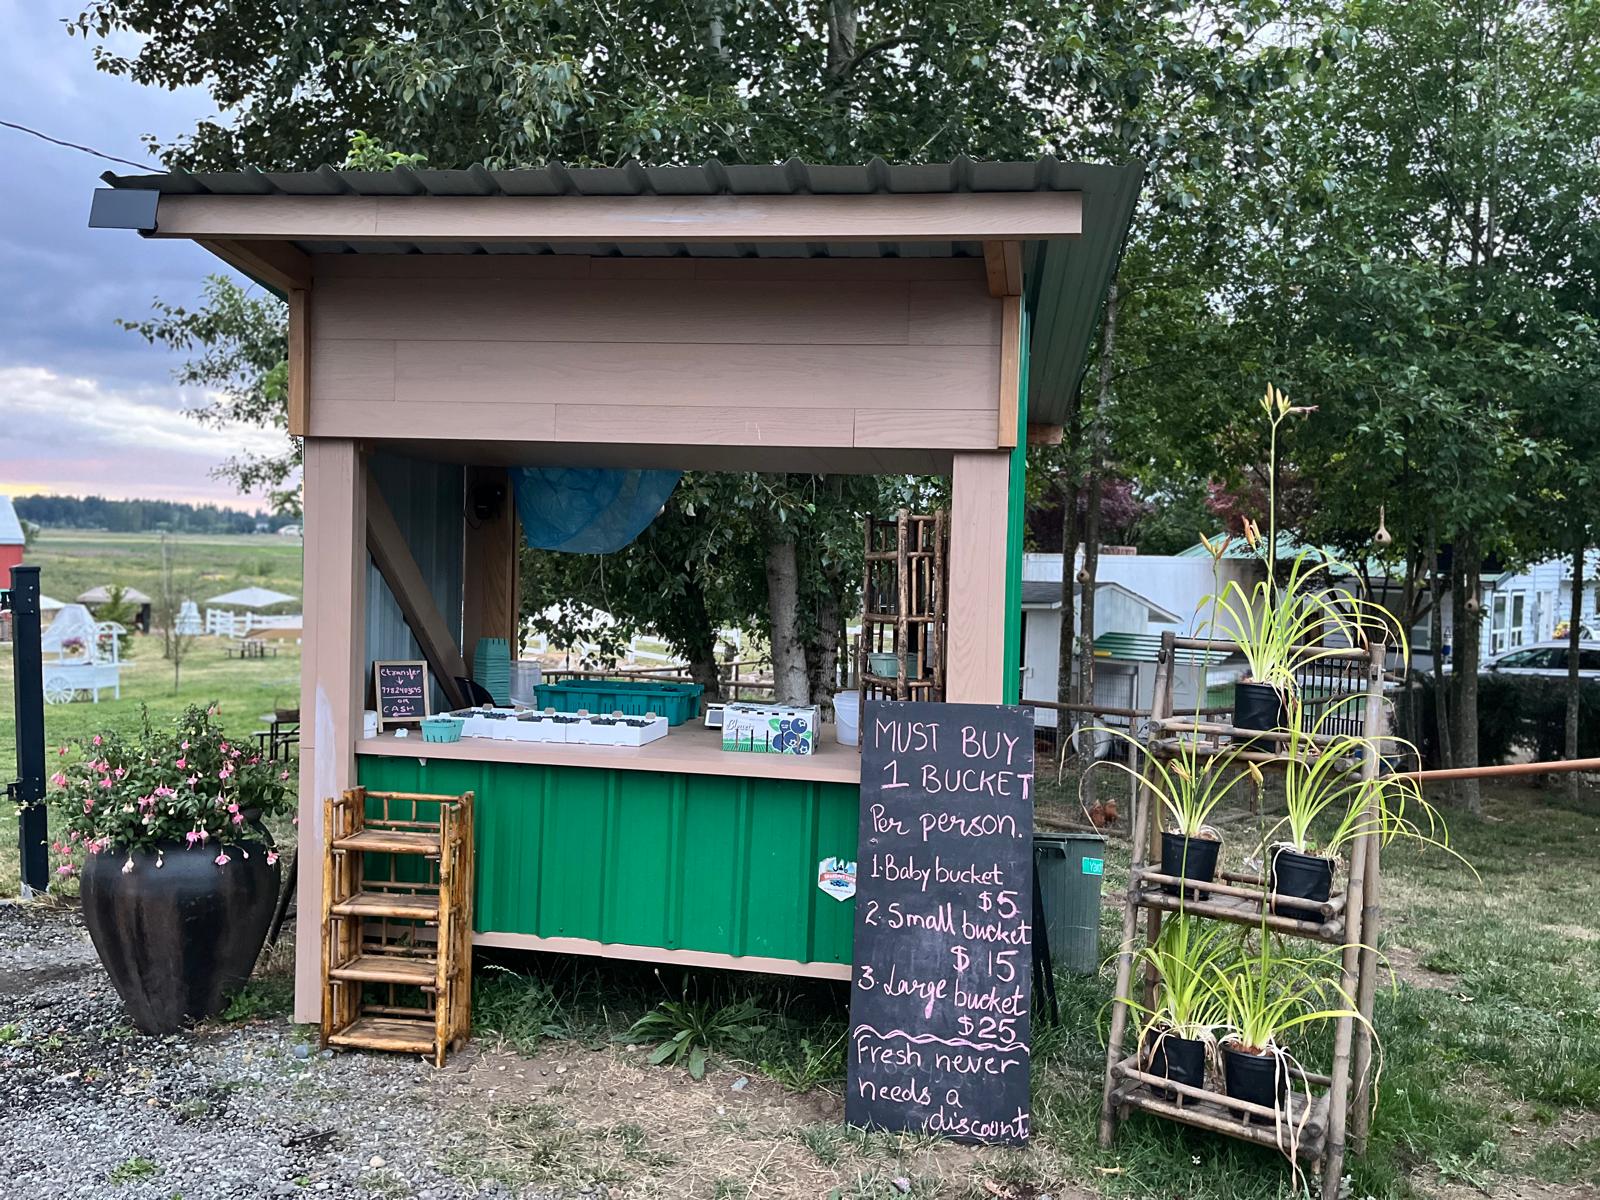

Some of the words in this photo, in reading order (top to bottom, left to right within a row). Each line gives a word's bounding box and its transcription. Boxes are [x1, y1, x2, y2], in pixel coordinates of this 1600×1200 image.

[875, 718, 940, 753] MUST
[961, 726, 1020, 765] BUY
[881, 760, 910, 790] 1
[921, 765, 1034, 800] BUCKET
[870, 804, 910, 835] Per
[919, 812, 1023, 842] person.
[935, 856, 1004, 885] bucket
[888, 902, 956, 936] Small
[962, 910, 1032, 945] bucket
[883, 963, 948, 1019] Large
[954, 977, 1028, 1017] bucket
[857, 1034, 922, 1067] Fresh
[935, 1051, 1020, 1075] never
[858, 1077, 931, 1105] needs
[945, 1088, 963, 1109] a
